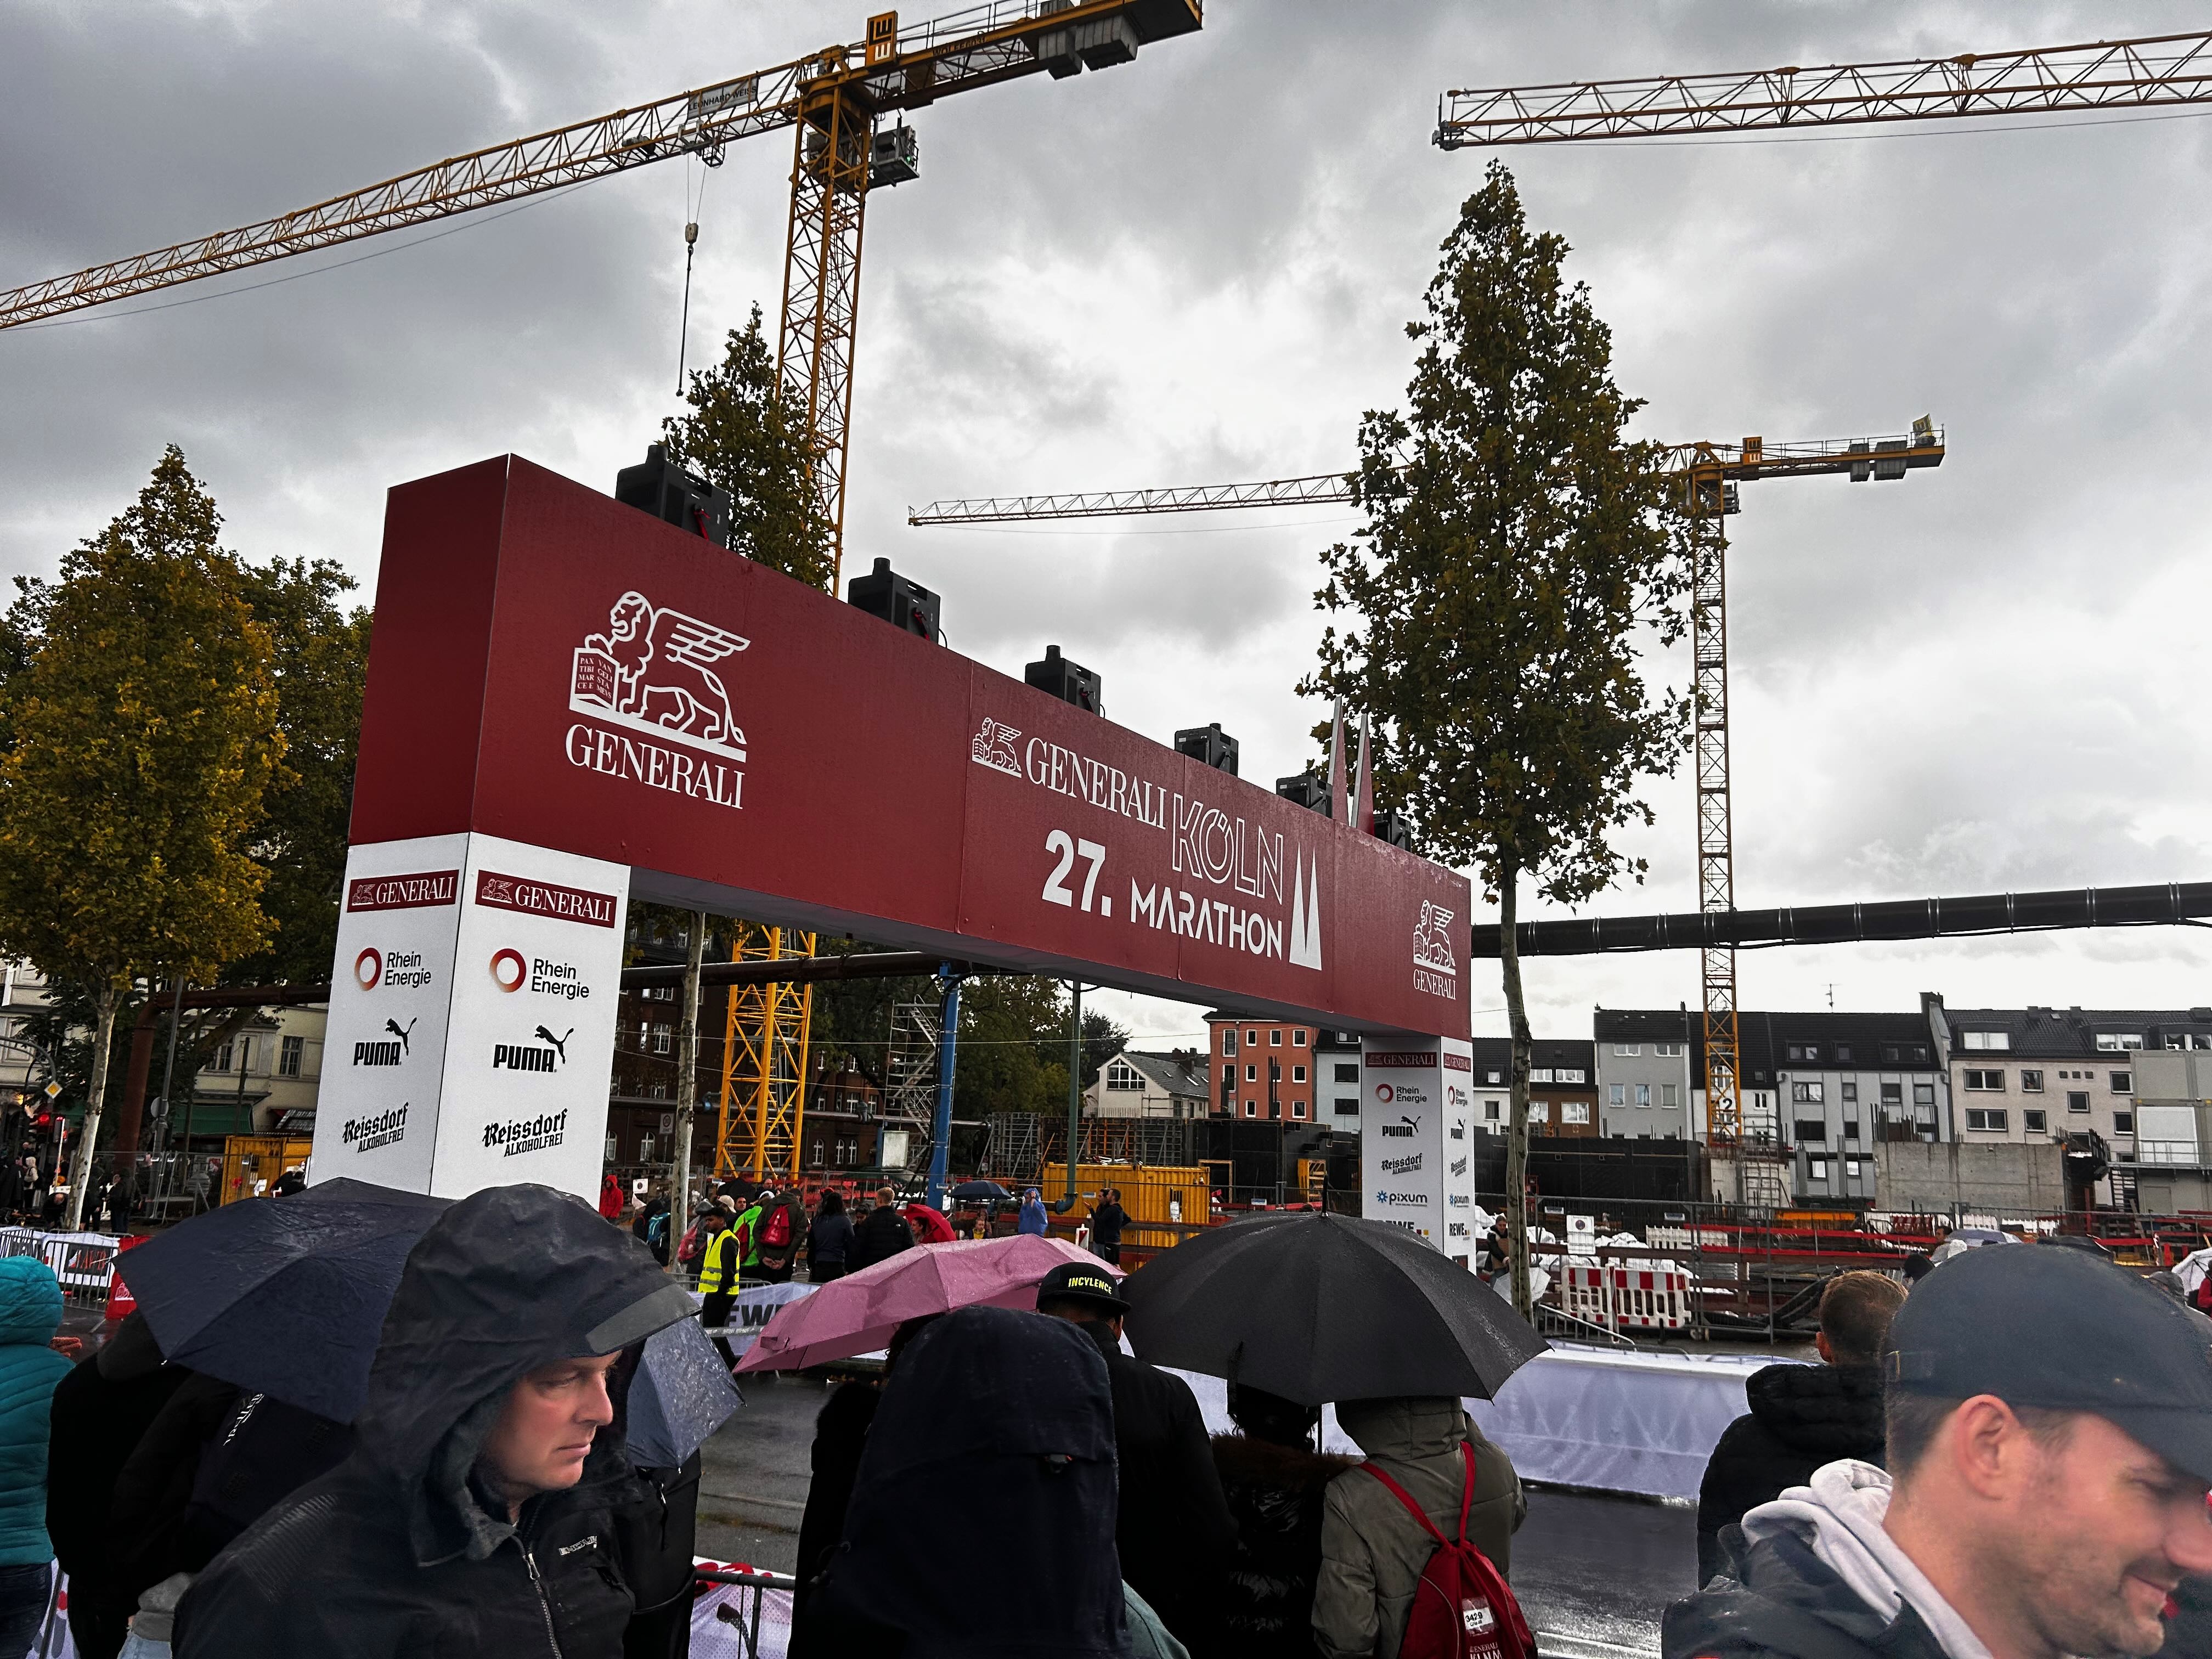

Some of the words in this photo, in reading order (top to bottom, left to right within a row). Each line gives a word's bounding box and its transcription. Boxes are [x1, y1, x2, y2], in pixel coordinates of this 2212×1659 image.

[732, 86, 757, 98] WEISS
[597, 668, 613, 683] GELI
[597, 676, 610, 690] STA
[566, 724, 746, 810] GENERALI
[1025, 737, 1166, 830] GENERALI
[1172, 792, 1284, 905] KÖLN
[376, 876, 455, 904] GENERALI
[1042, 829, 1112, 918] 27.
[1131, 876, 1282, 960] MARATHON
[515, 884, 613, 922] GENERALI
[386, 951, 421, 968] Rhein
[532, 958, 577, 980] Rhein
[385, 969, 431, 989] Energie
[531, 977, 590, 1000] Energie
[1413, 969, 1456, 1001] GENERALI
[353, 1041, 401, 1066] PUMA
[493, 1044, 556, 1073] PUMA
[1384, 1054, 1434, 1065] GENERALI
[1450, 1057, 1470, 1070] GENERALI
[1396, 1086, 1419, 1094] Rhein
[1396, 1094, 1427, 1103] Energie
[1723, 1098, 1734, 1113] 2
[342, 1102, 409, 1144] Reissdorf
[482, 1108, 568, 1148] Reissdorf
[1382, 1125, 1413, 1137] PUMA
[357, 1128, 404, 1153] ALKOHOLFREI
[504, 1132, 563, 1157] ALKOHOLFREI
[1381, 1153, 1423, 1171] Reissdorf
[1389, 1193, 1427, 1205] pixum
[1449, 1222, 1465, 1237] REWE
[1068, 1277, 1113, 1295] INCYLENCE
